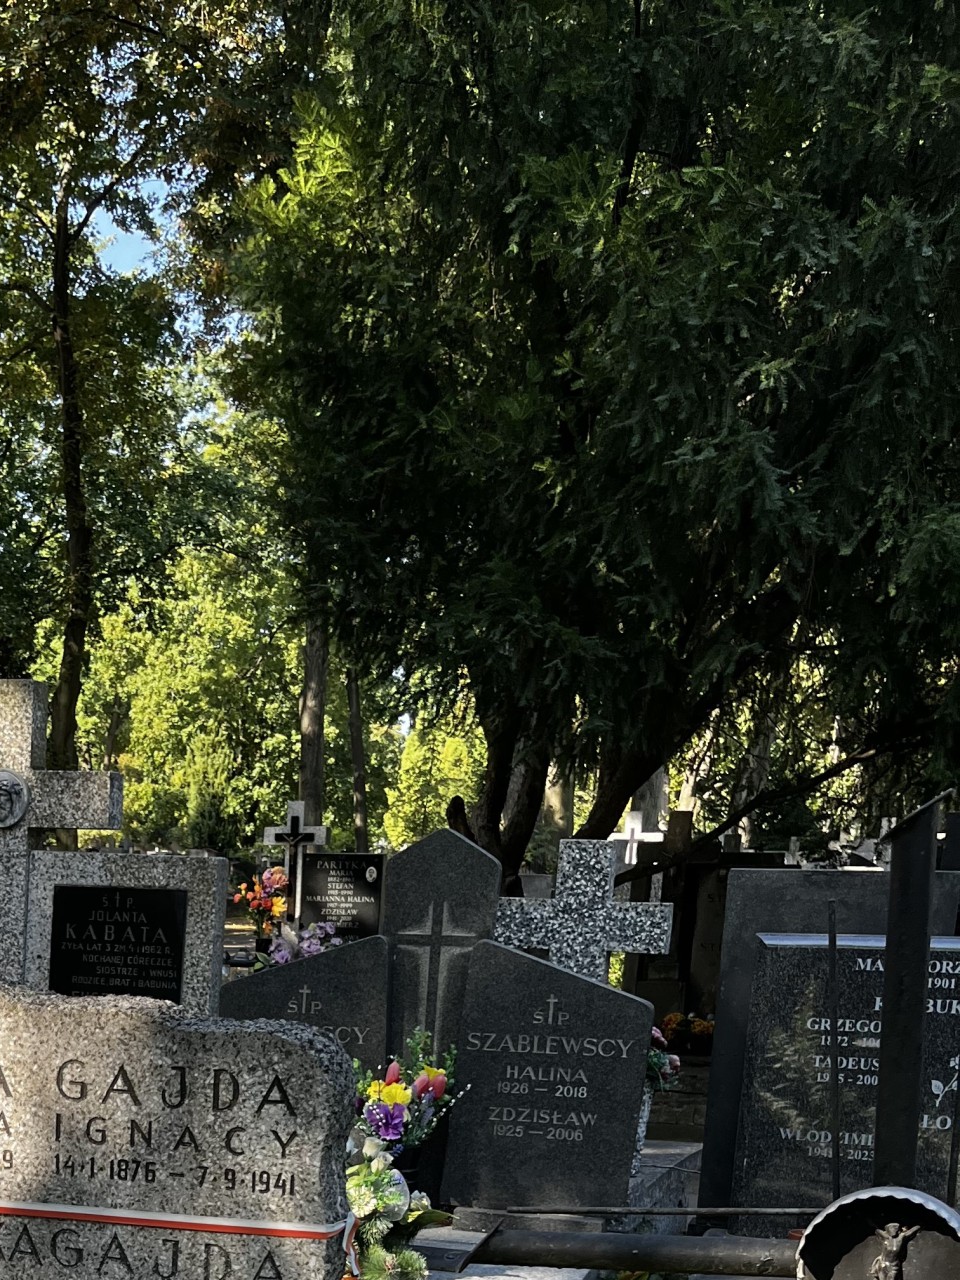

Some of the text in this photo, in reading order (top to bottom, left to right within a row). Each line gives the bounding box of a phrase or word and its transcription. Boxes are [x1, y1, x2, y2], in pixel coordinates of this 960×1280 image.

[88, 910, 148, 923] JOLANTA
[66, 923, 168, 943] KABATA
[96, 966, 138, 976] SIOSTRZE
[466, 1032, 635, 1058] SZABLEWSCY
[506, 1065, 589, 1083] HALINA
[56, 1059, 298, 1117] GAJDA
[497, 1081, 529, 1095] 1926
[554, 1085, 588, 1098] 2018
[488, 1106, 598, 1127] ZDZISŁAW
[55, 1112, 298, 1159] IGNACY
[493, 1125, 524, 1138] 1925
[546, 1127, 584, 1142] 2006
